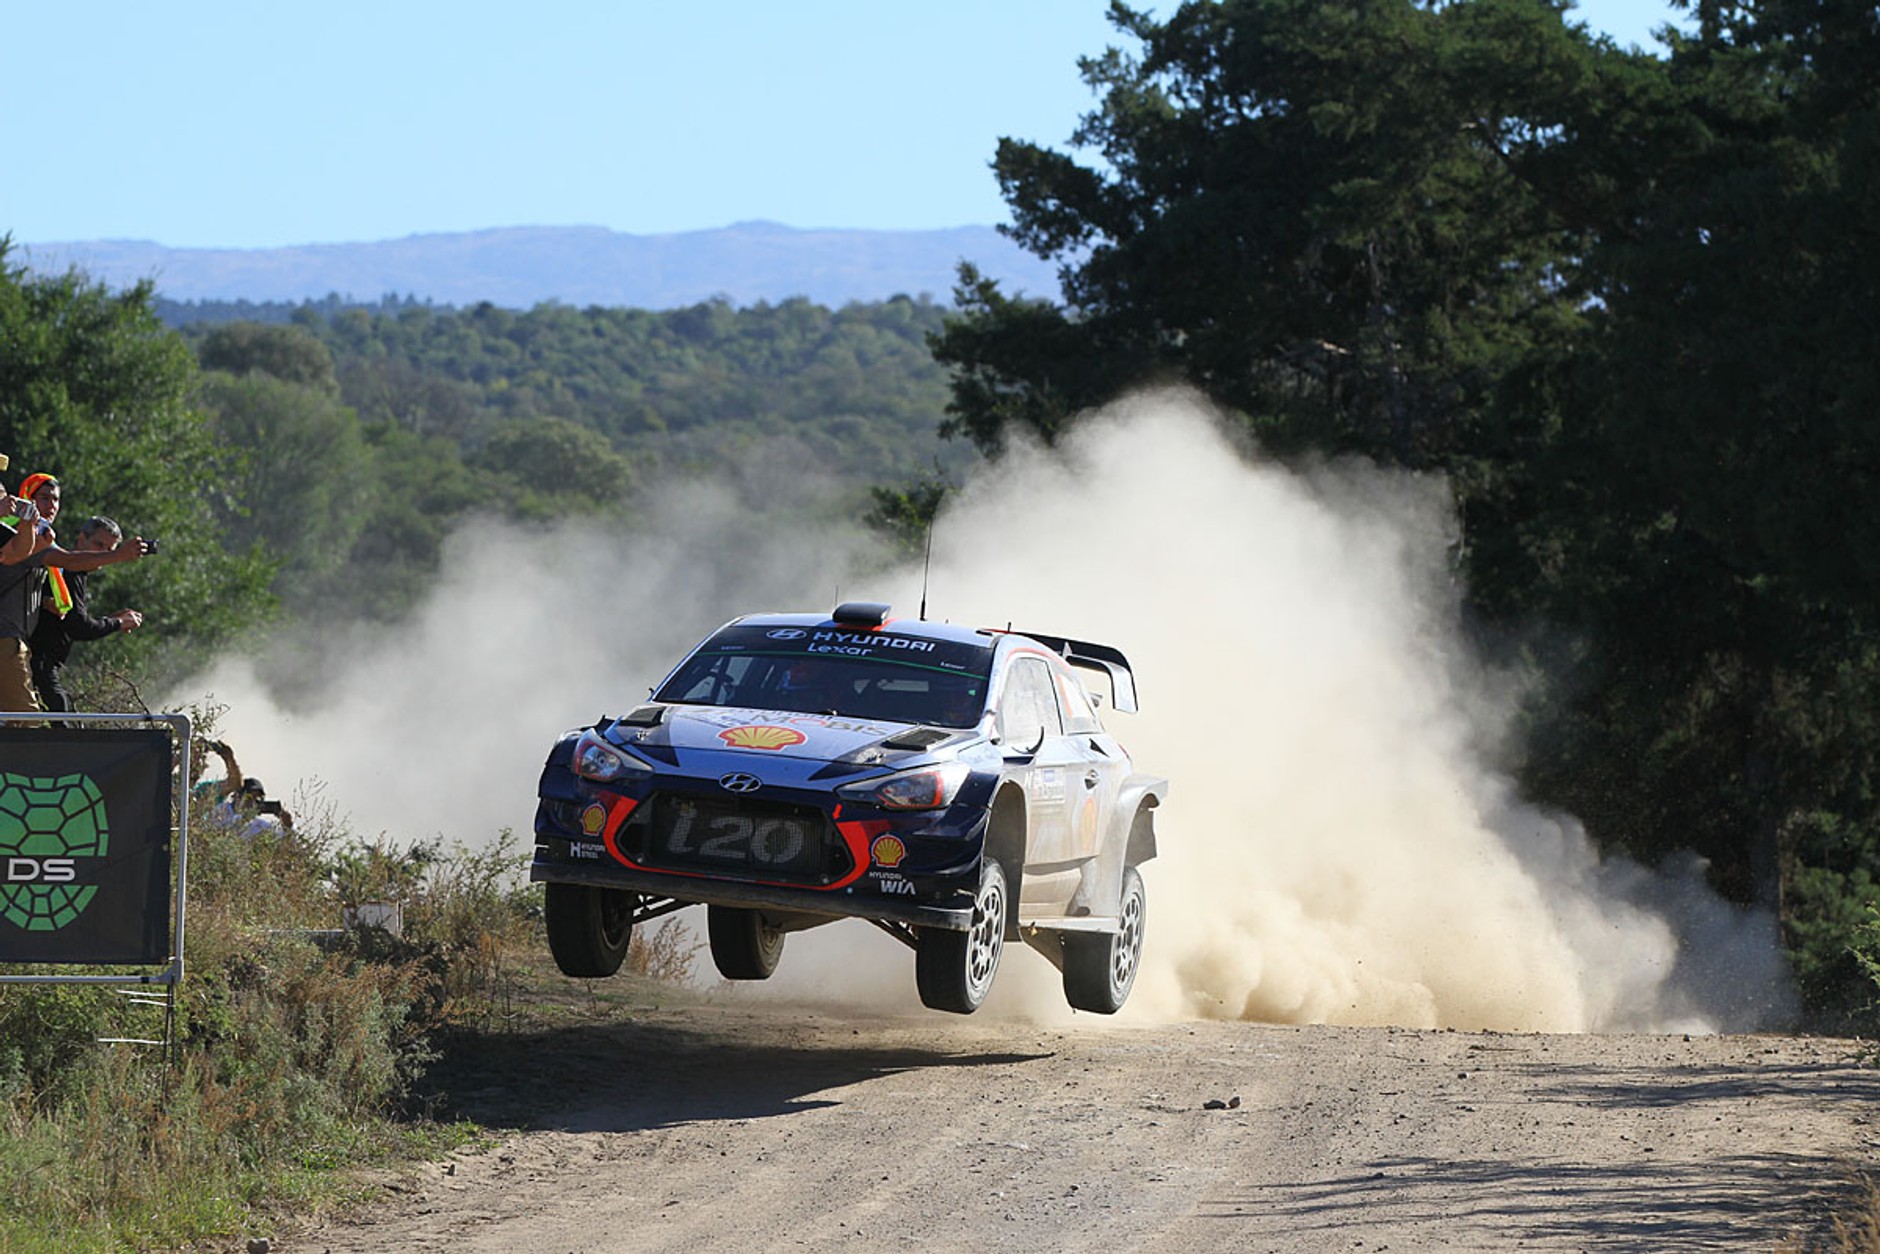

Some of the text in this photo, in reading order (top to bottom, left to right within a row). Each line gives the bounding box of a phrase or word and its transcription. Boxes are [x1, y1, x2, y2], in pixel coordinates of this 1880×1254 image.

[807, 642, 873, 656] Lexar
[812, 631, 936, 652] HYUNDAI
[667, 801, 804, 864] i20
[7, 858, 76, 881] DS
[880, 878, 917, 895] WIA
